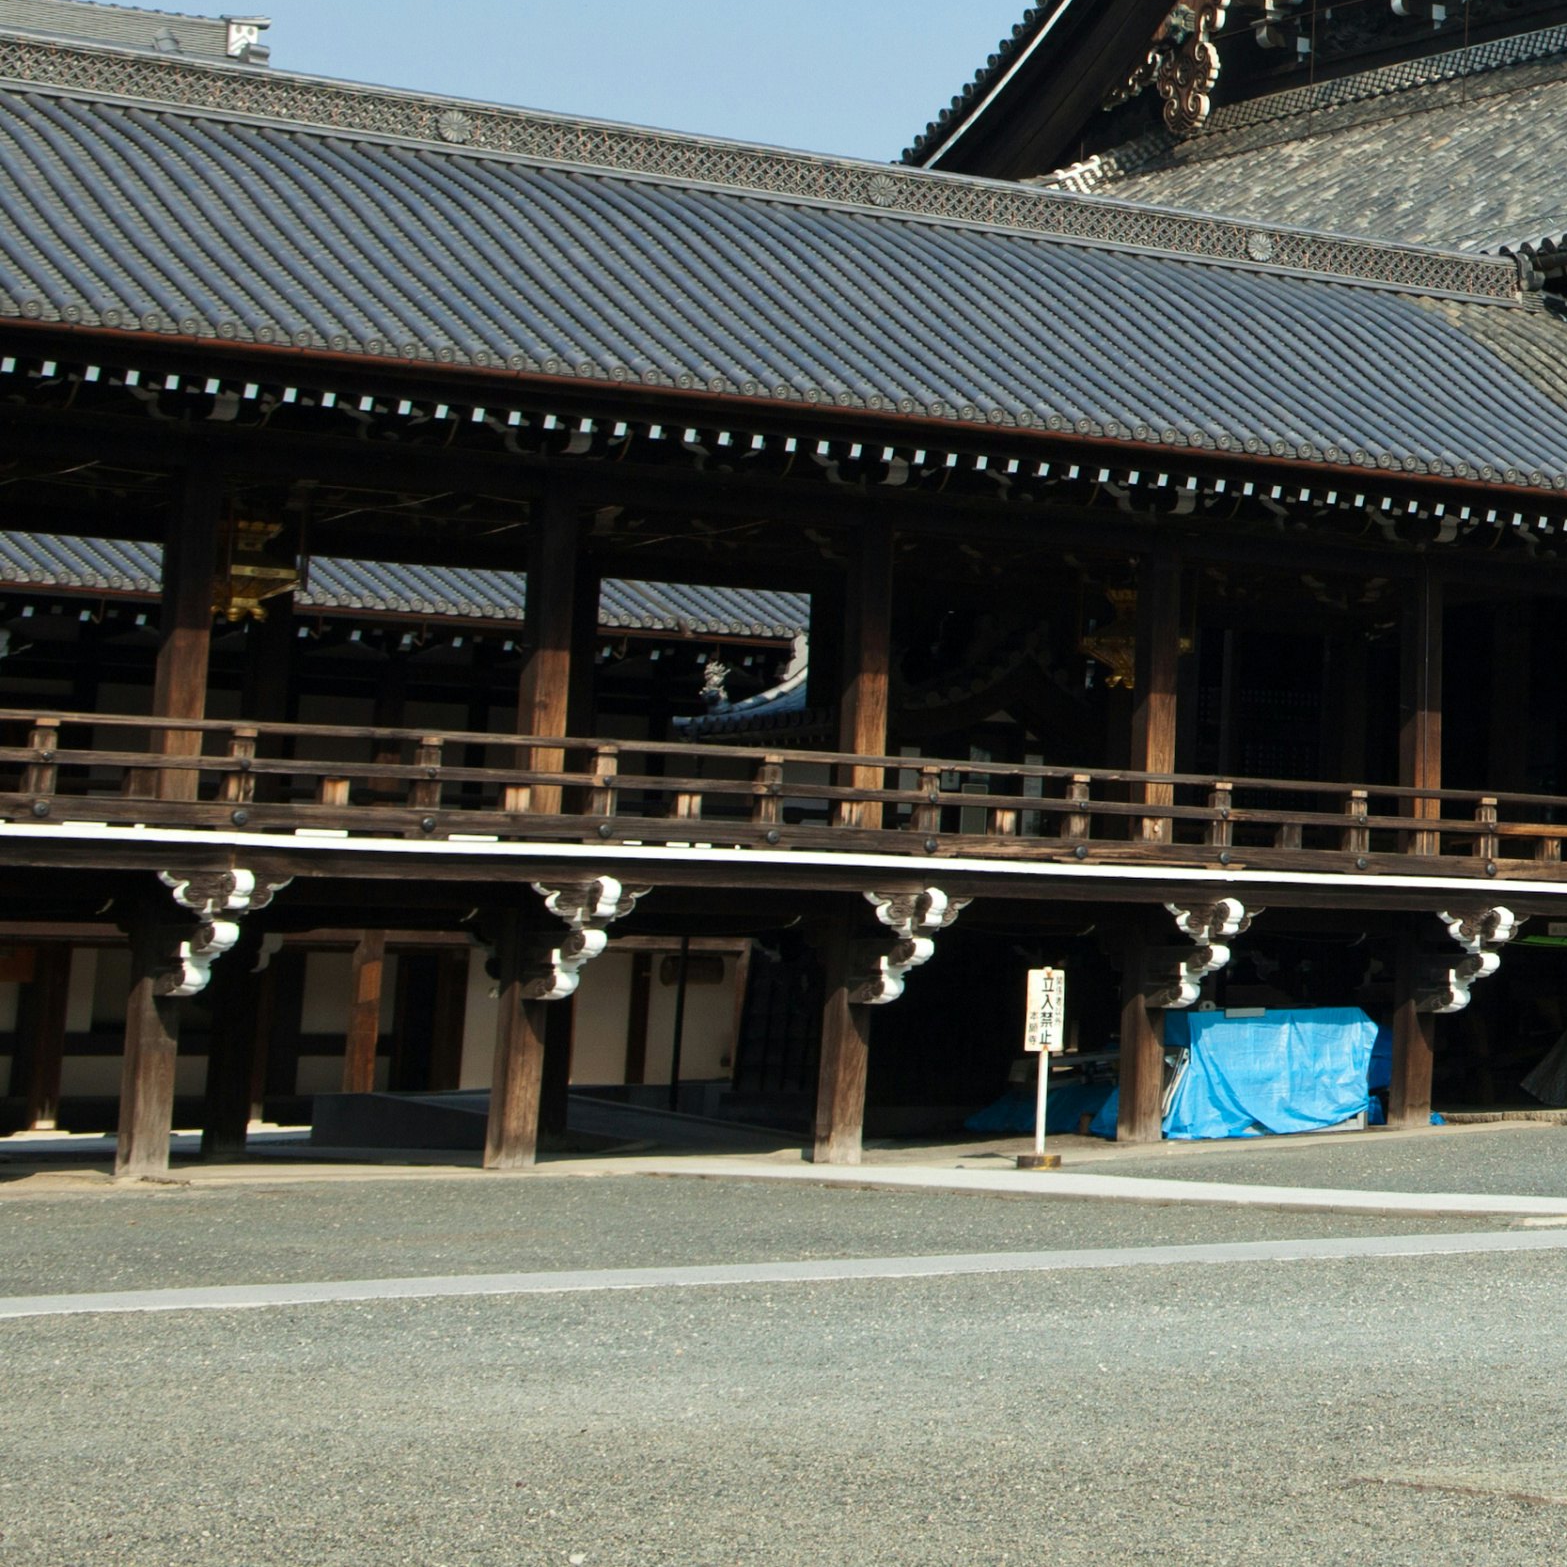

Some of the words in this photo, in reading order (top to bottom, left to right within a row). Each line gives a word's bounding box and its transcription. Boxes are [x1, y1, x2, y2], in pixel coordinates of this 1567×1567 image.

[1028, 1011, 1038, 1045] 本願寺
[1039, 977, 1054, 1045] 立入禁止
